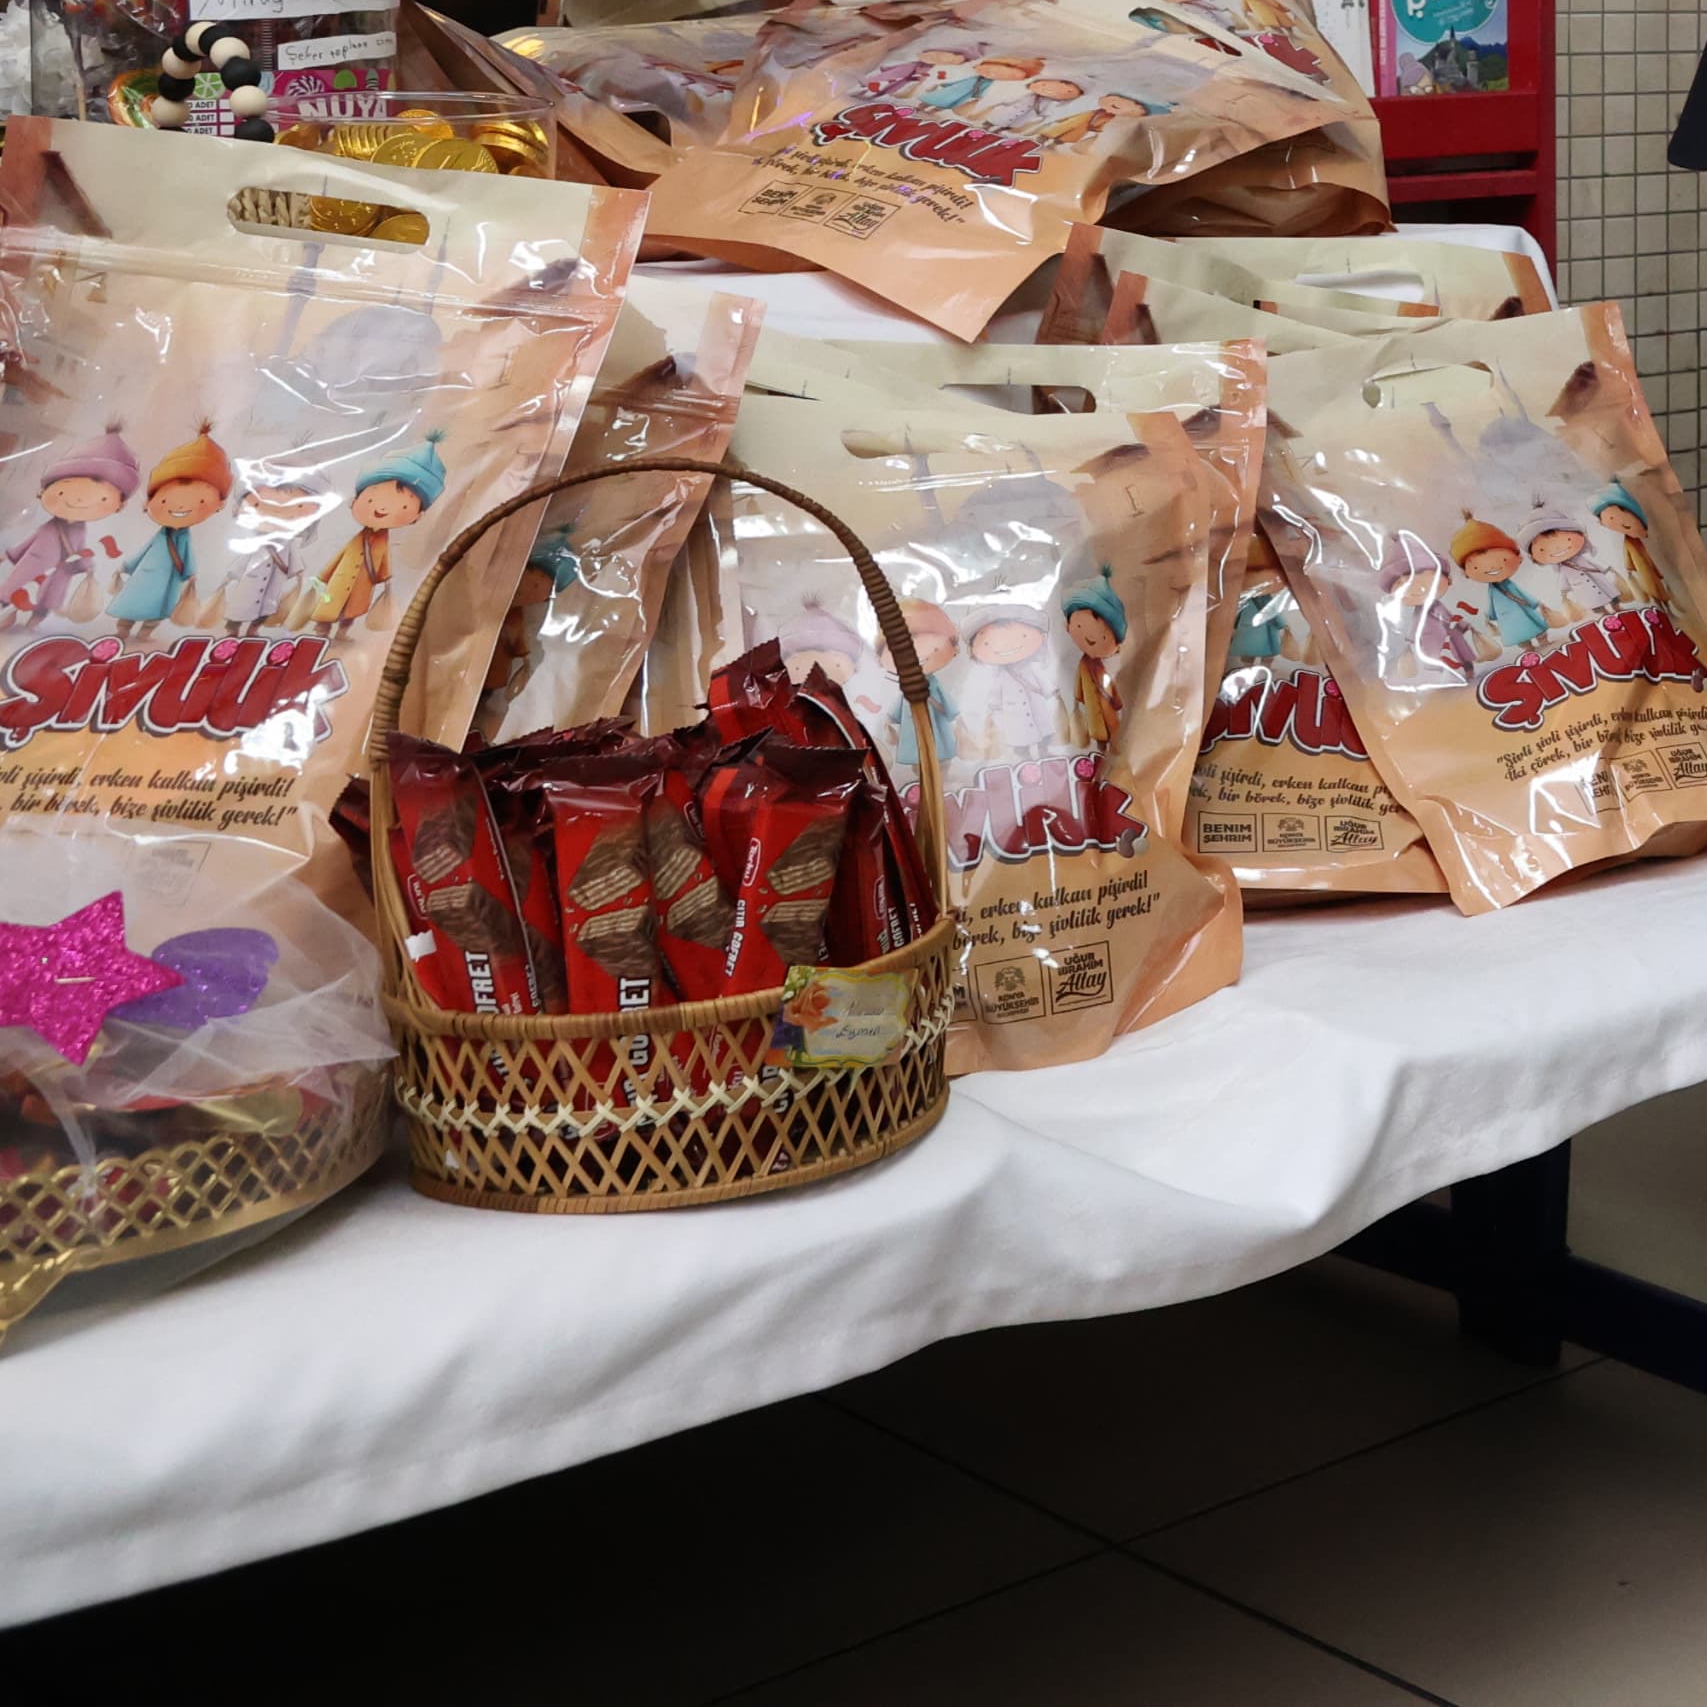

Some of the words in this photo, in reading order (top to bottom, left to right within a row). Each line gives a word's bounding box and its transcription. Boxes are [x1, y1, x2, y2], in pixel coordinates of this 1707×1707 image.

[0, 635, 350, 752] Şivlilik
[90, 768, 141, 789] erken
[216, 776, 297, 802] pişirdi!
[1271, 774, 1313, 791] erken
[1318, 776, 1370, 794] kalkan
[10, 794, 41, 812] bir
[109, 795, 147, 820] bize
[151, 797, 216, 823] şivlilik
[1098, 869, 1149, 906] pişirdi!
[1049, 905, 1102, 940] şivlilik
[1063, 952, 1095, 966] UĞUR
[464, 950, 500, 1015] OFRET
